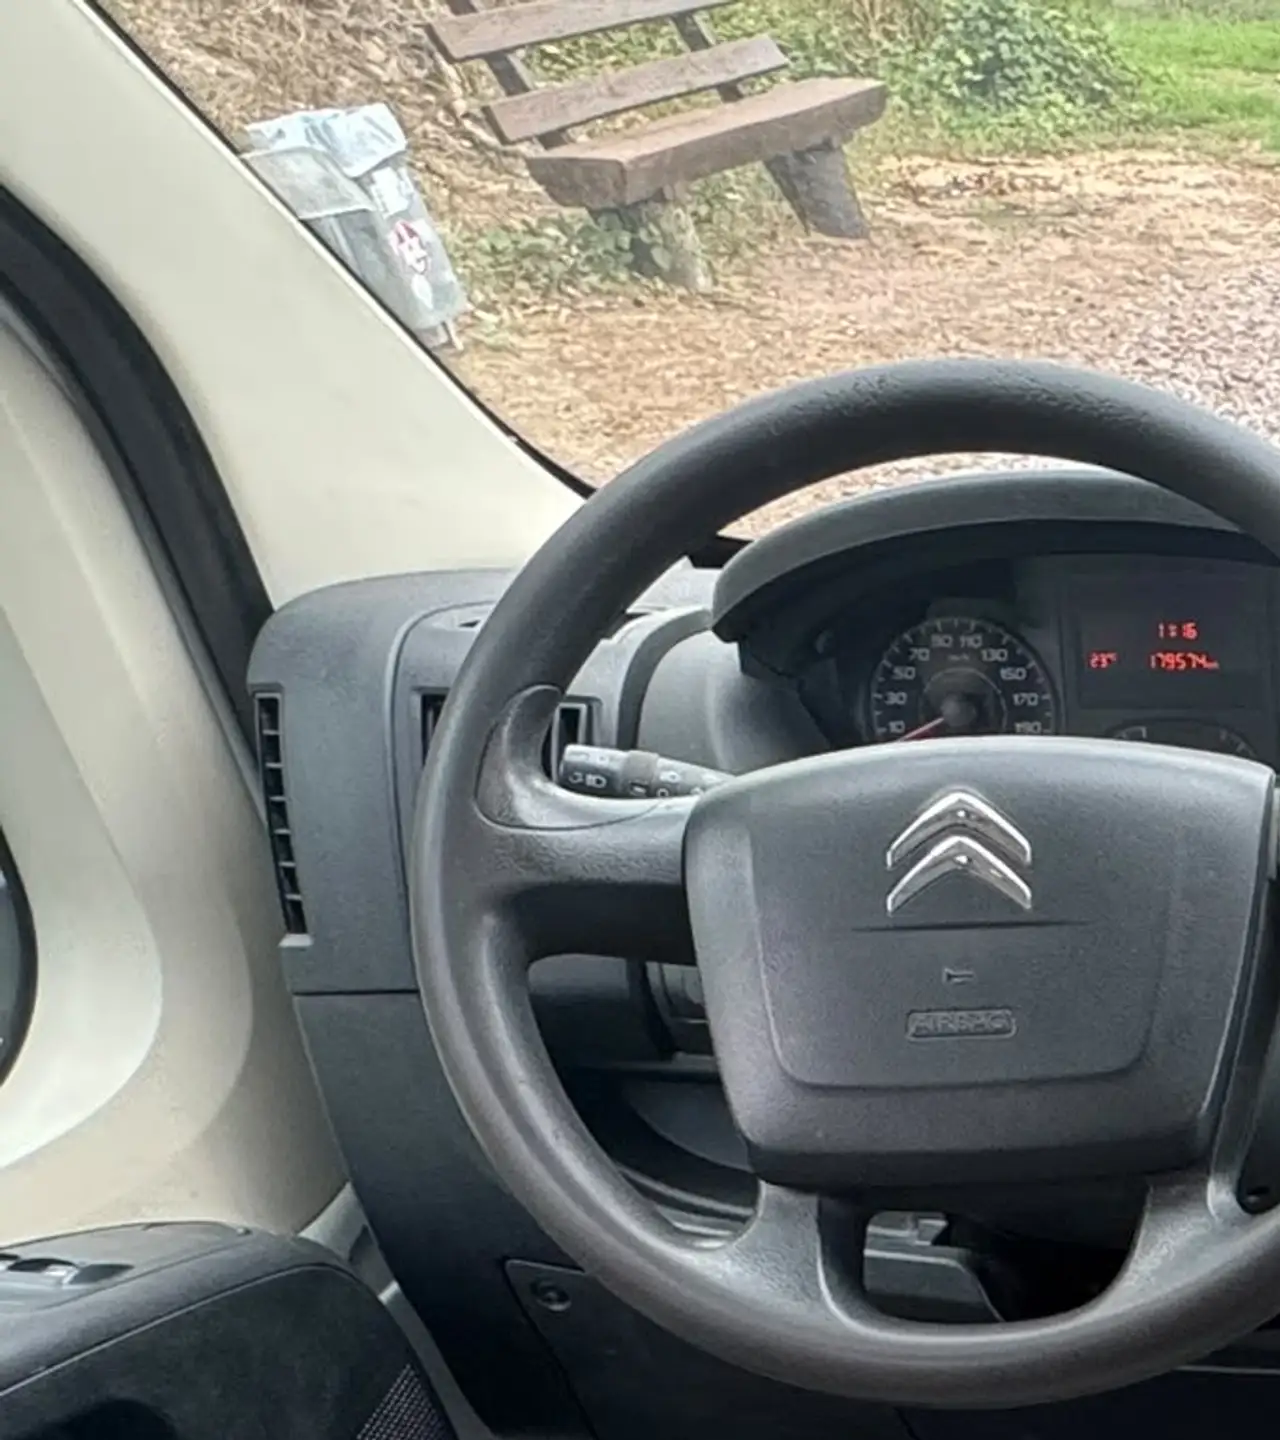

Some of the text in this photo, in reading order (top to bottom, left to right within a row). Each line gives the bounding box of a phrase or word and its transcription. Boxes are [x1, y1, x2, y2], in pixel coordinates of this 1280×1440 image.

[960, 634, 983, 648] 110
[908, 648, 931, 662] 70
[981, 648, 1008, 662] 130
[892, 667, 916, 680] 50
[1000, 667, 1027, 681] 150
[884, 692, 907, 706] 30
[1012, 692, 1039, 707] 170
[888, 720, 905, 734] 10
[1014, 721, 1042, 734] 190
